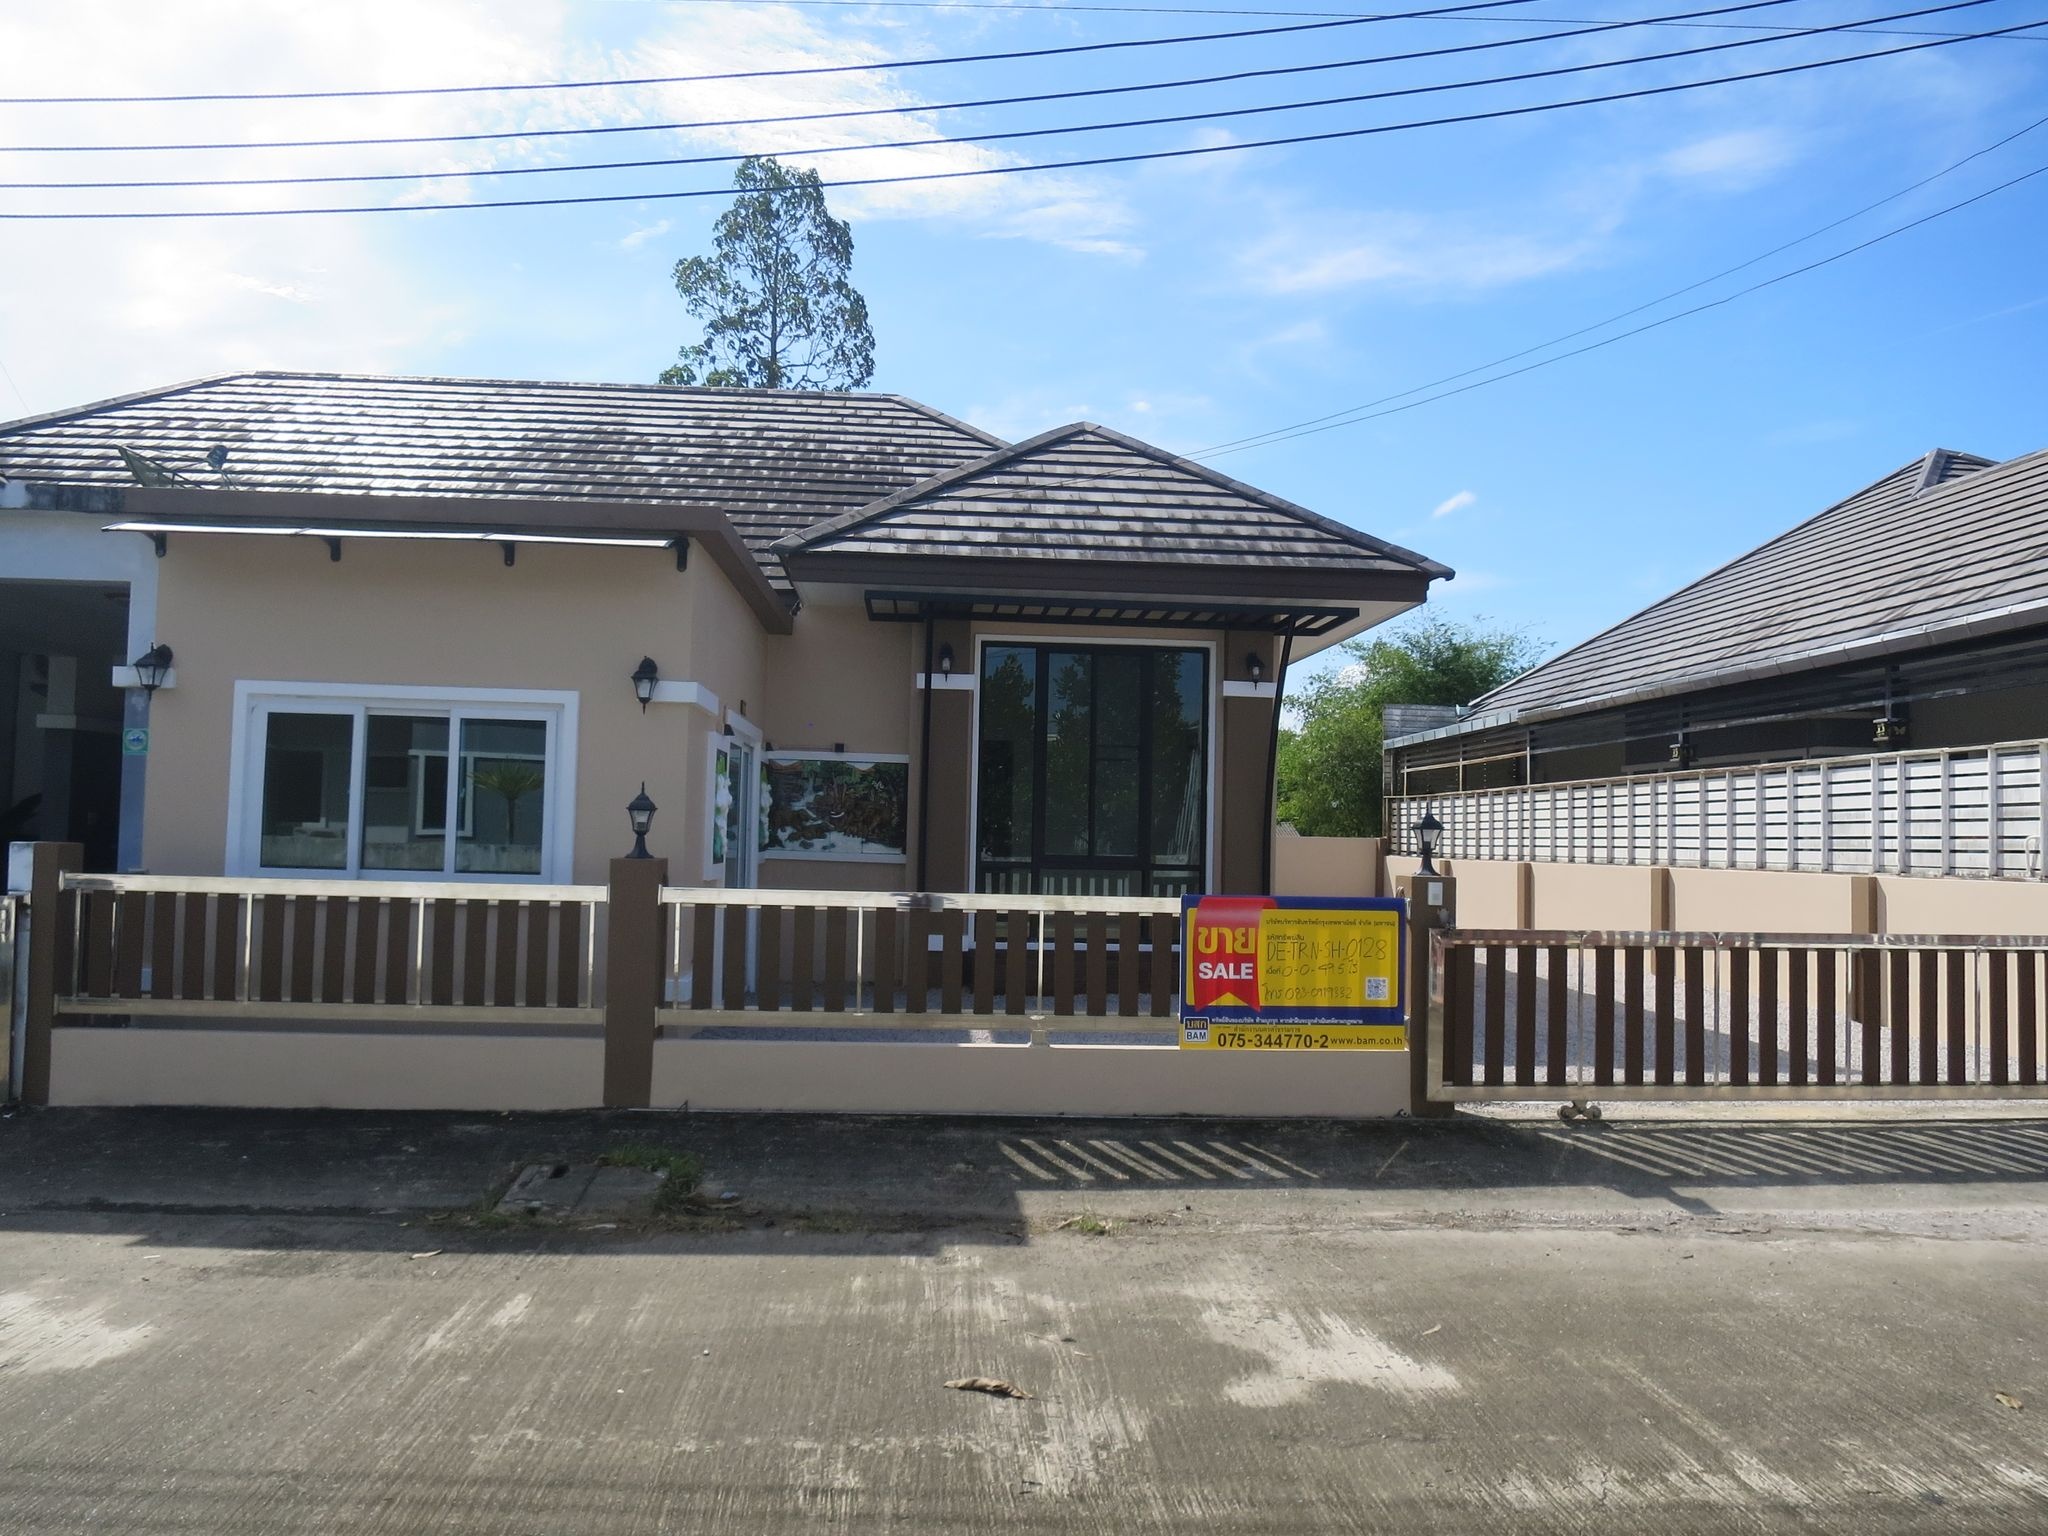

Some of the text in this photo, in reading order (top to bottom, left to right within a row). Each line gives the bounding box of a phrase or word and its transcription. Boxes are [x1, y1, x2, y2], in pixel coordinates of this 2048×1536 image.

[1198, 927, 1255, 954] ขาย
[1199, 962, 1253, 980] SALE
[1187, 1021, 1207, 1029] บสก
[1186, 1032, 1207, 1040] BAM
[1217, 1034, 1403, 1048] 075-344770-2 www.bam.co.th
